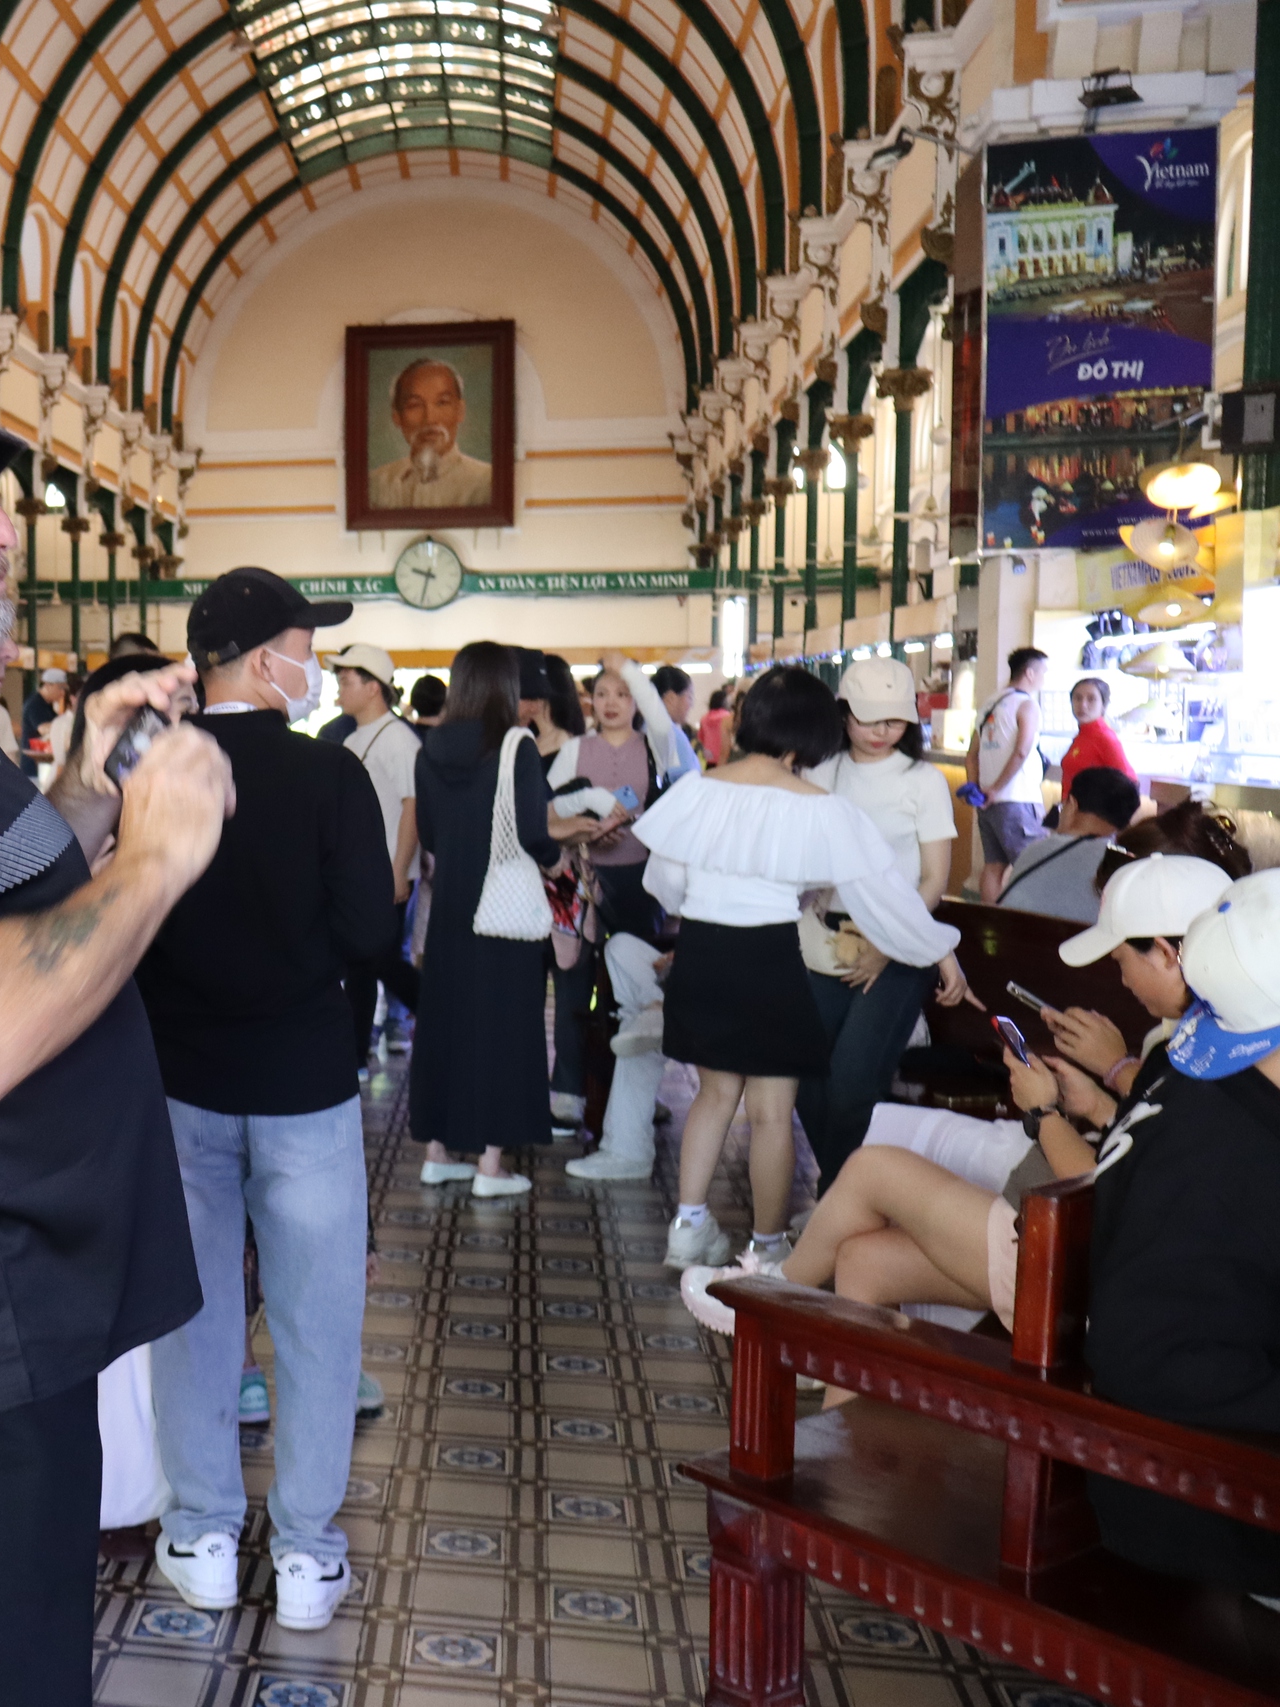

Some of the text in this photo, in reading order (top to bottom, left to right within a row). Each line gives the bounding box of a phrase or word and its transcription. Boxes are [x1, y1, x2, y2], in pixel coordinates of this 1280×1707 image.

[299, 579, 348, 594] CHÍNH
[352, 578, 384, 593] XÁC
[478, 577, 496, 590] AN
[498, 574, 536, 590] TOÀN
[650, 574, 689, 587] MINH
